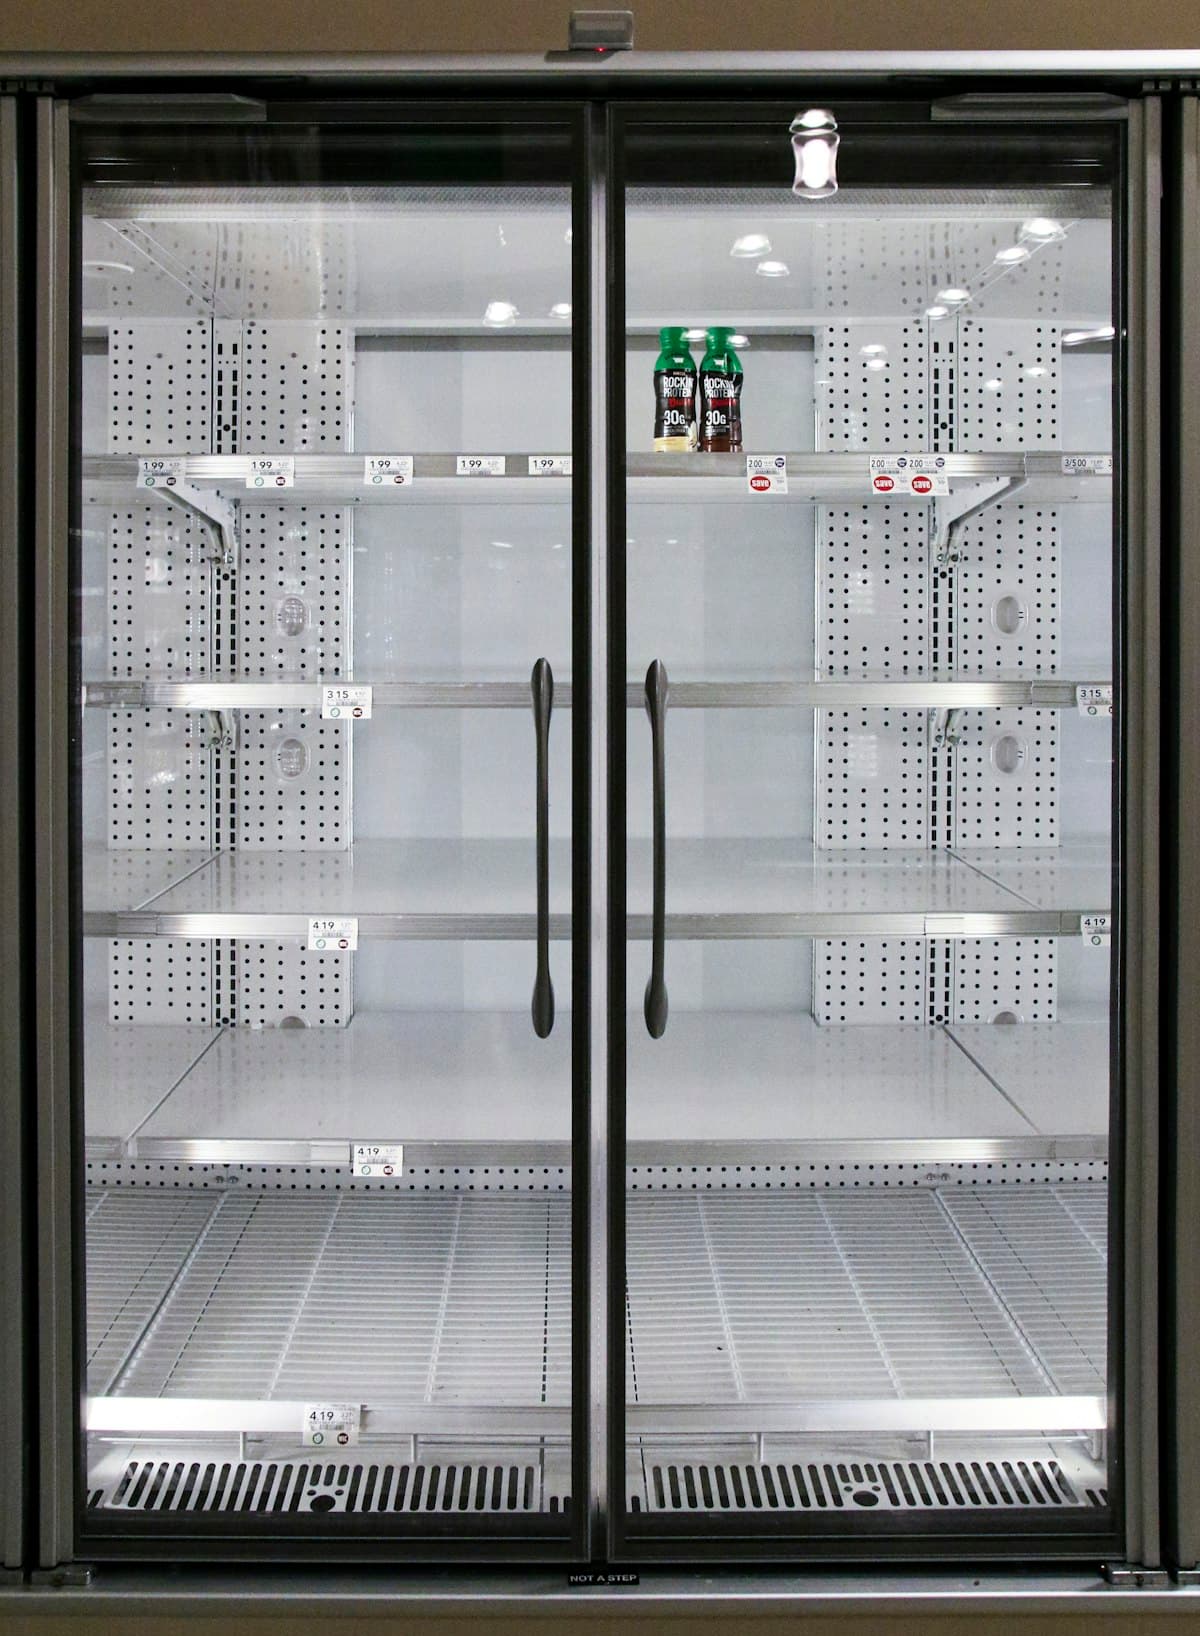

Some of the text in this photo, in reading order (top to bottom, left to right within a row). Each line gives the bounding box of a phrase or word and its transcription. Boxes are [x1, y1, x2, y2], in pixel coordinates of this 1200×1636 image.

[704, 388, 735, 399] PROTEIN
[569, 1574, 593, 1583] NOT
[607, 1573, 637, 1582] STEP
